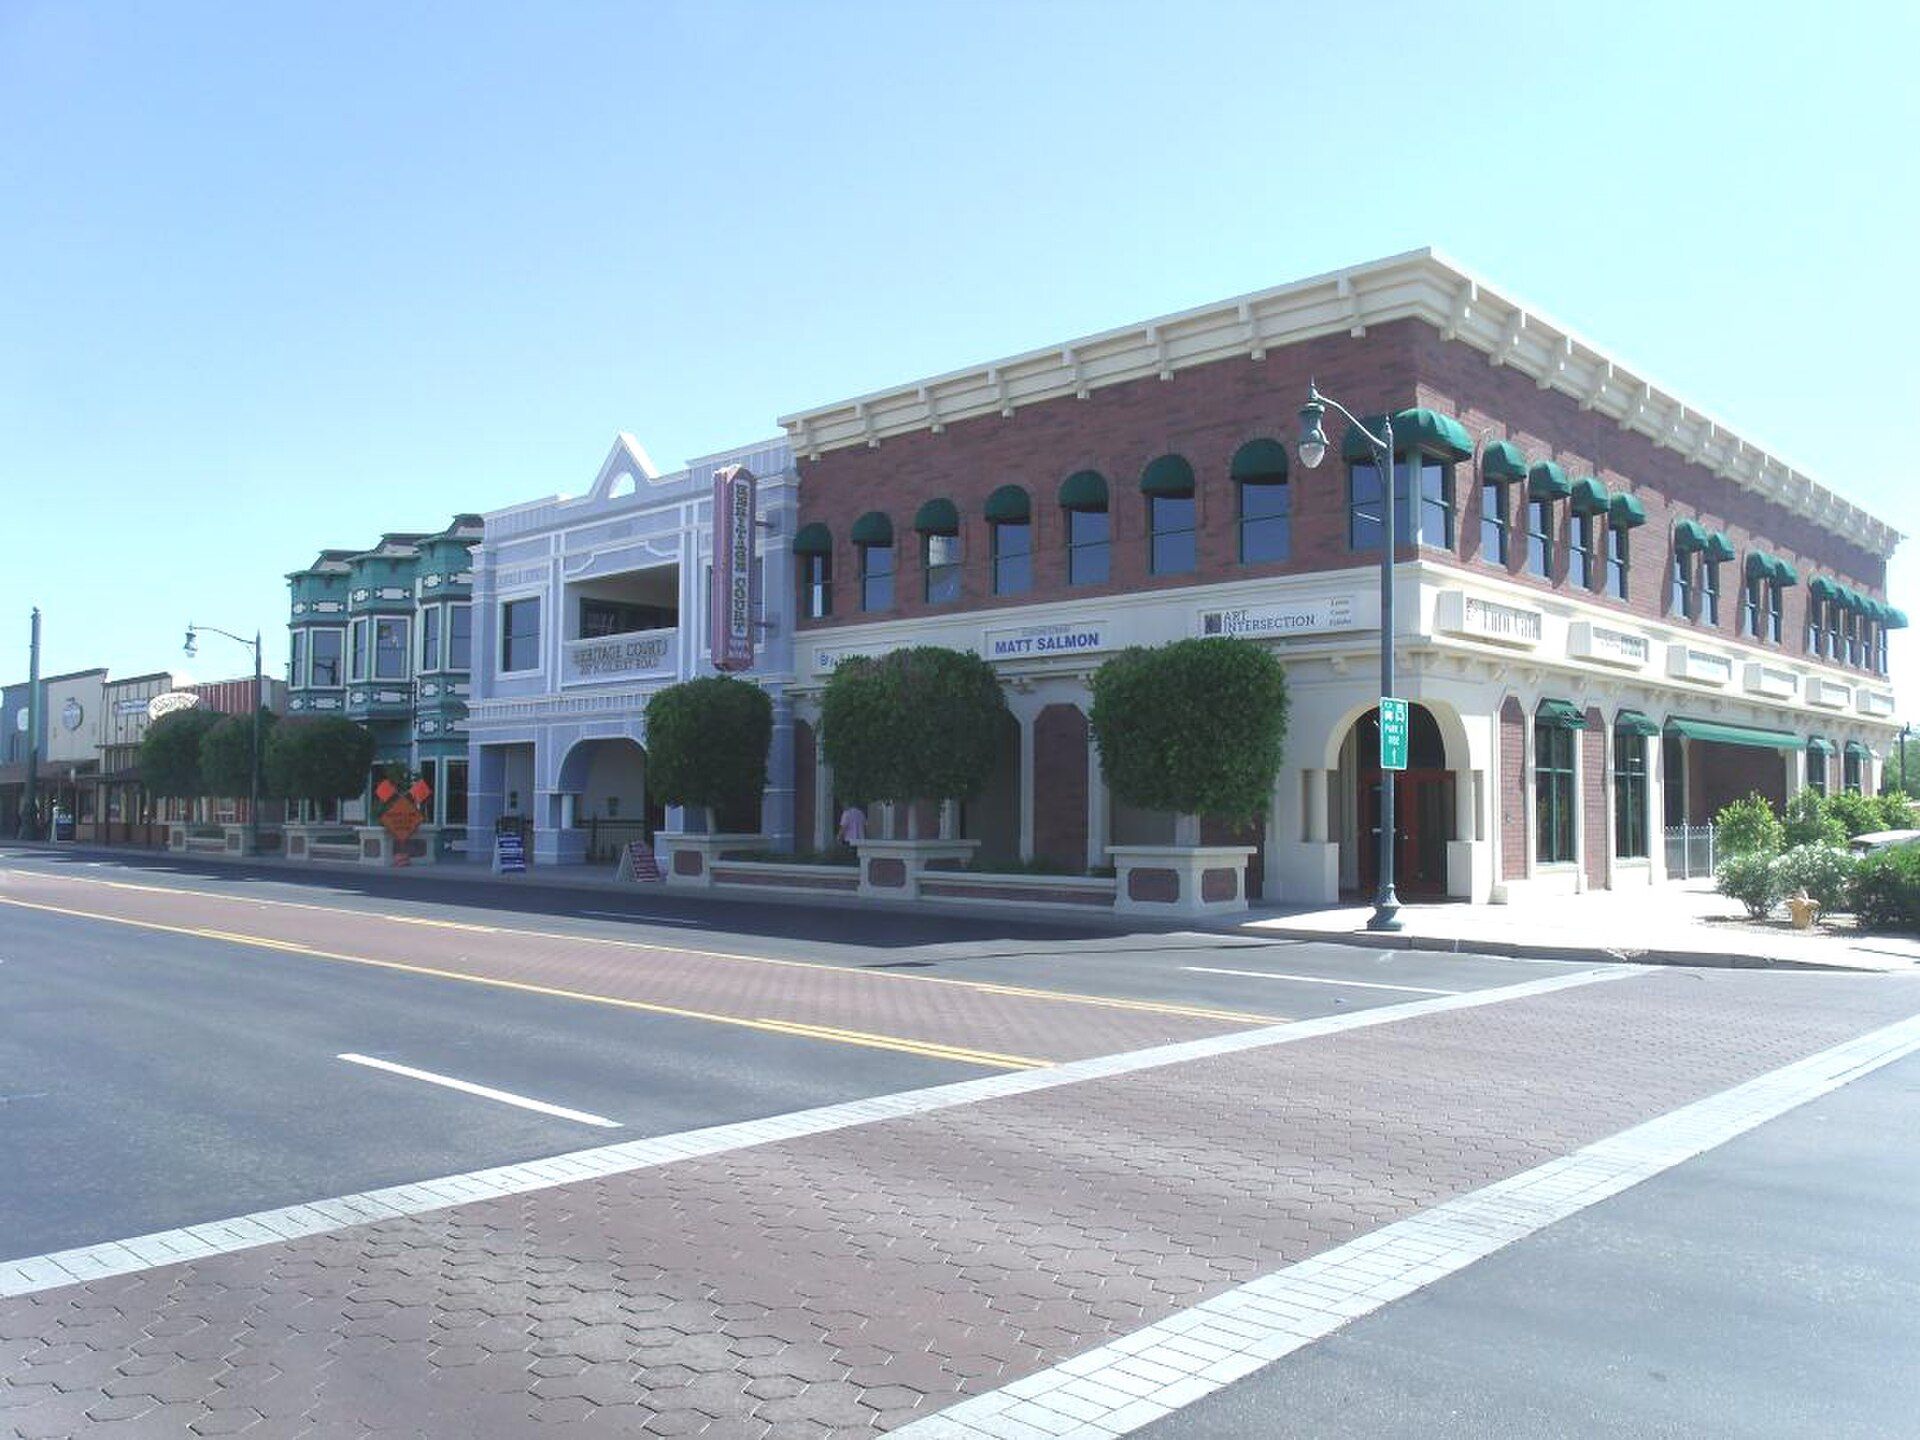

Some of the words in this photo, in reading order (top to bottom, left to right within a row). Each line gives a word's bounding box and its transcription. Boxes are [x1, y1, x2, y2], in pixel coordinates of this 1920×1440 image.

[1222, 613, 1315, 635] INTERSECTION
[1223, 609, 1248, 622] ART
[995, 639, 1032, 655] MATT
[1037, 632, 1099, 651] SALMON
